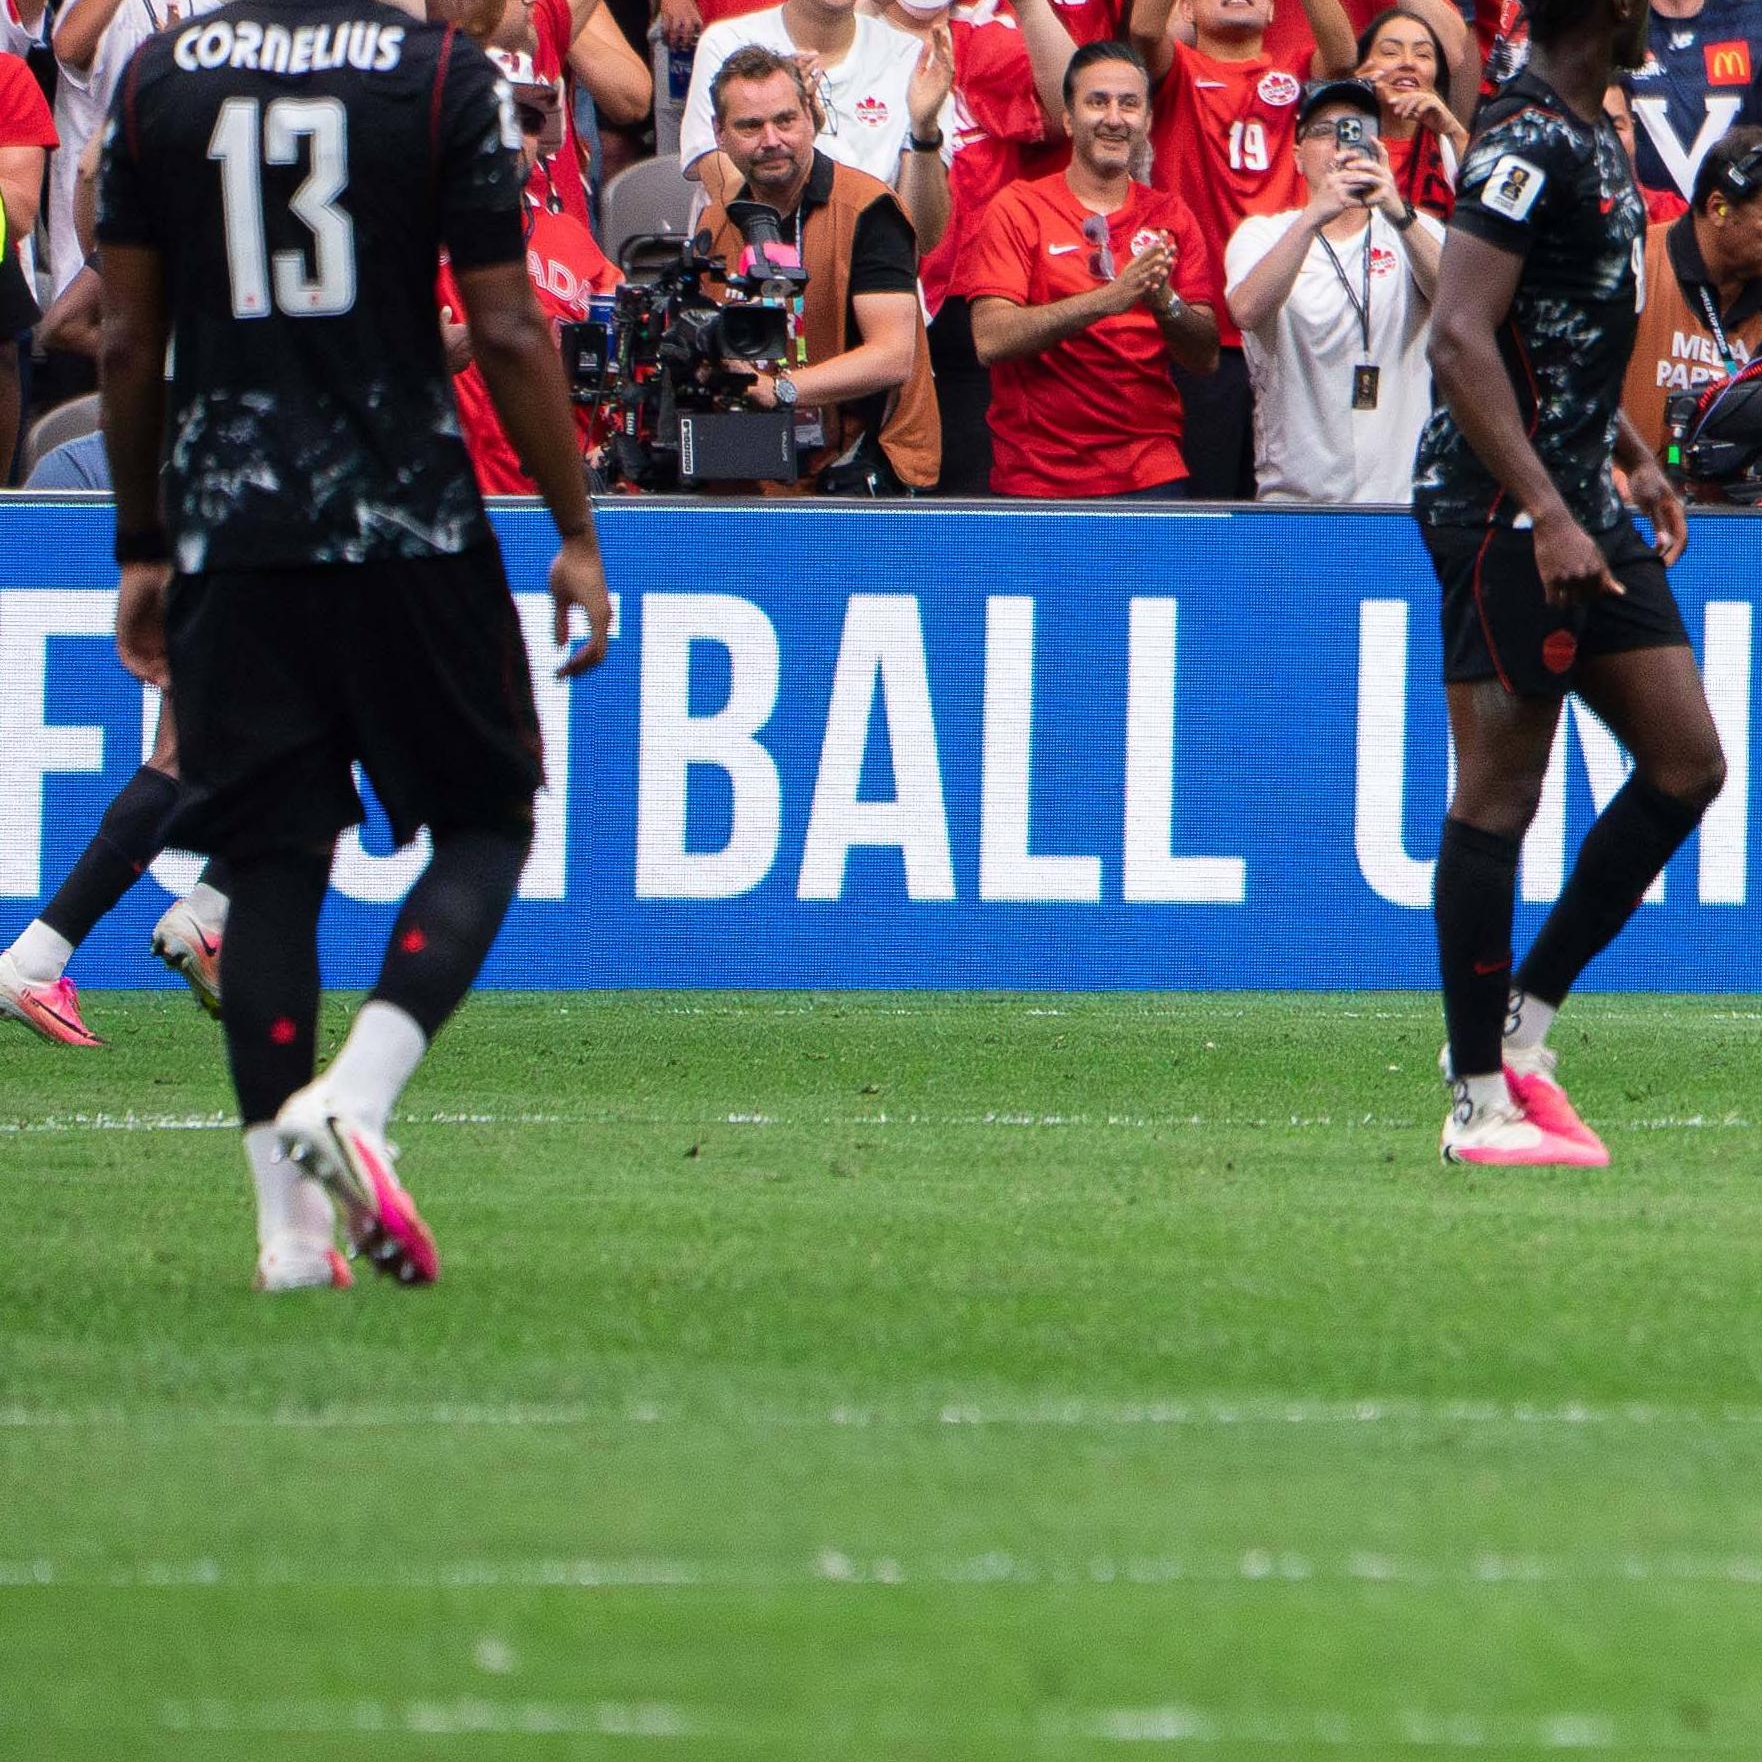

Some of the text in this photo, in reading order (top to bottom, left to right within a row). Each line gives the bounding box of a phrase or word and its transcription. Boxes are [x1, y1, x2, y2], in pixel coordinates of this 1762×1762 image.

[174, 20, 405, 75] CORNELIUS
[206, 95, 357, 320] 13
[1229, 119, 1270, 171] 19
[0, 588, 1248, 902] FTBALL
